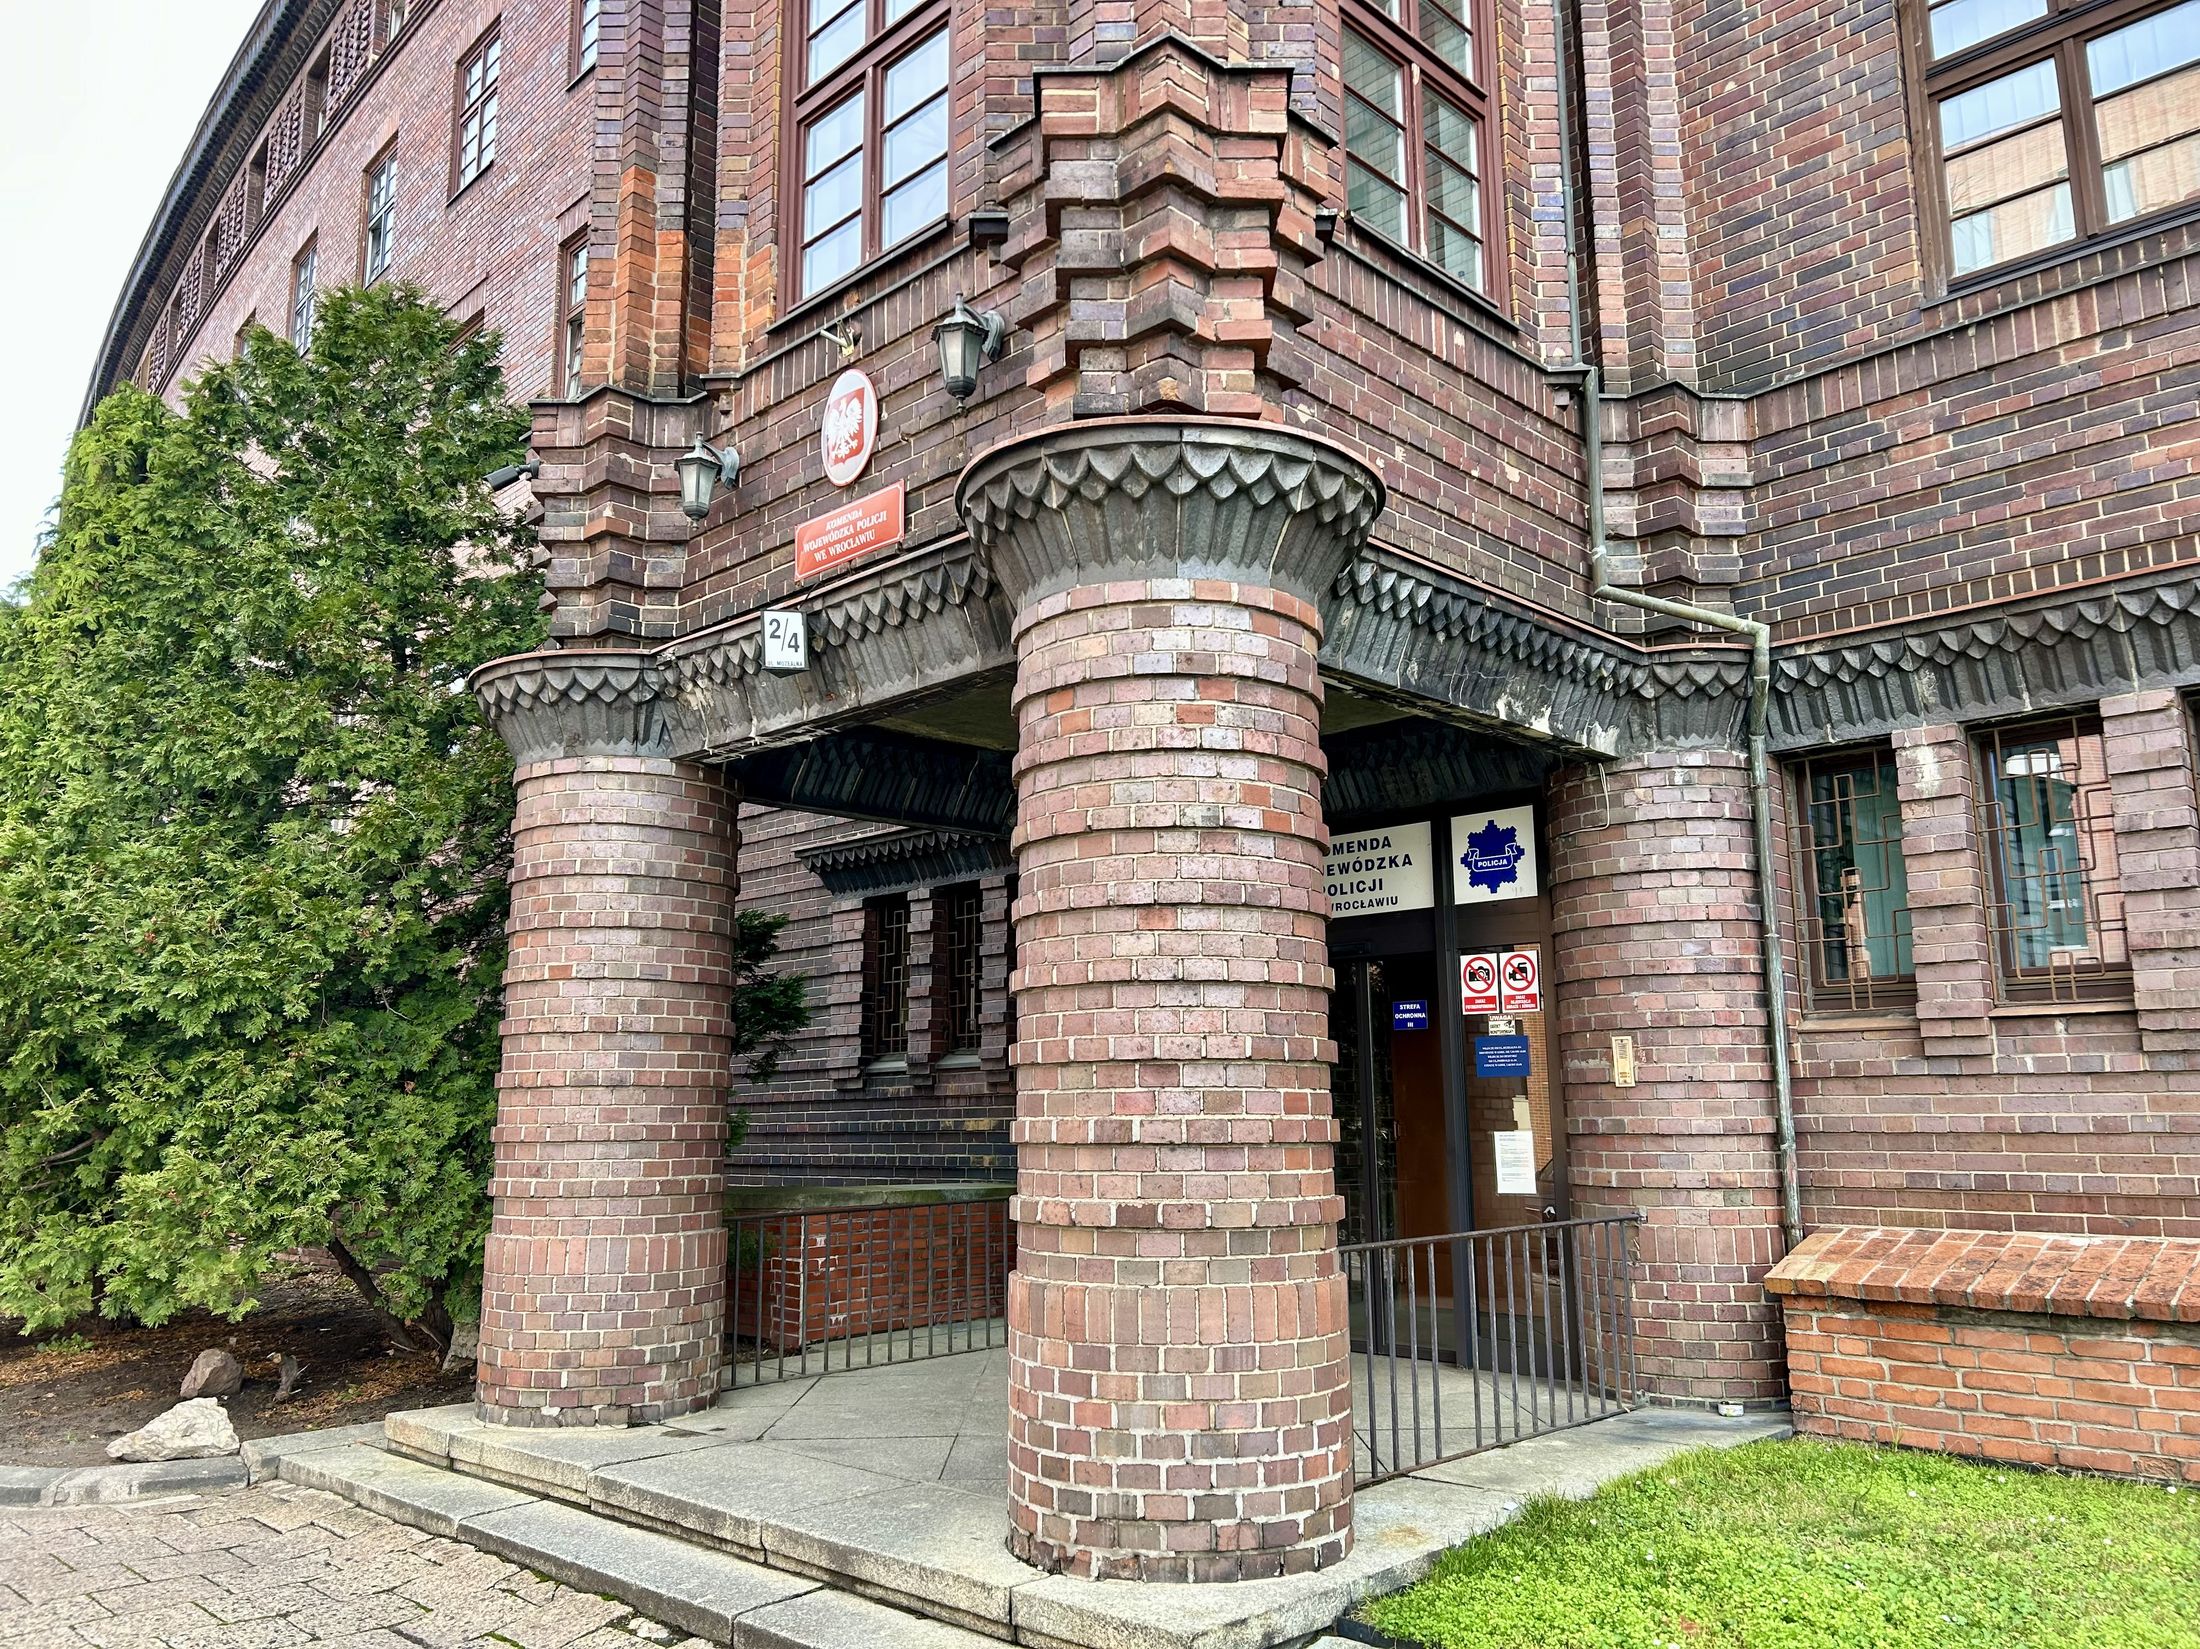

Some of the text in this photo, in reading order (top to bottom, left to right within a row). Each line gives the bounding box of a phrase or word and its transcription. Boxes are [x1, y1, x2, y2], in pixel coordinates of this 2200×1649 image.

[826, 509, 862, 531] KOMENDA
[803, 511, 887, 552] WOJEWÓDZKA POLICJI
[814, 529, 875, 562] WE WROCŁAWIU
[769, 618, 800, 653] 2/4
[1330, 835, 1392, 856] MENDA
[1322, 853, 1413, 877] EWÓDZKA
[1477, 858, 1508, 868] POLICJA
[1322, 878, 1384, 897] OLICJI
[1331, 895, 1399, 912] ROCŁAWIU
